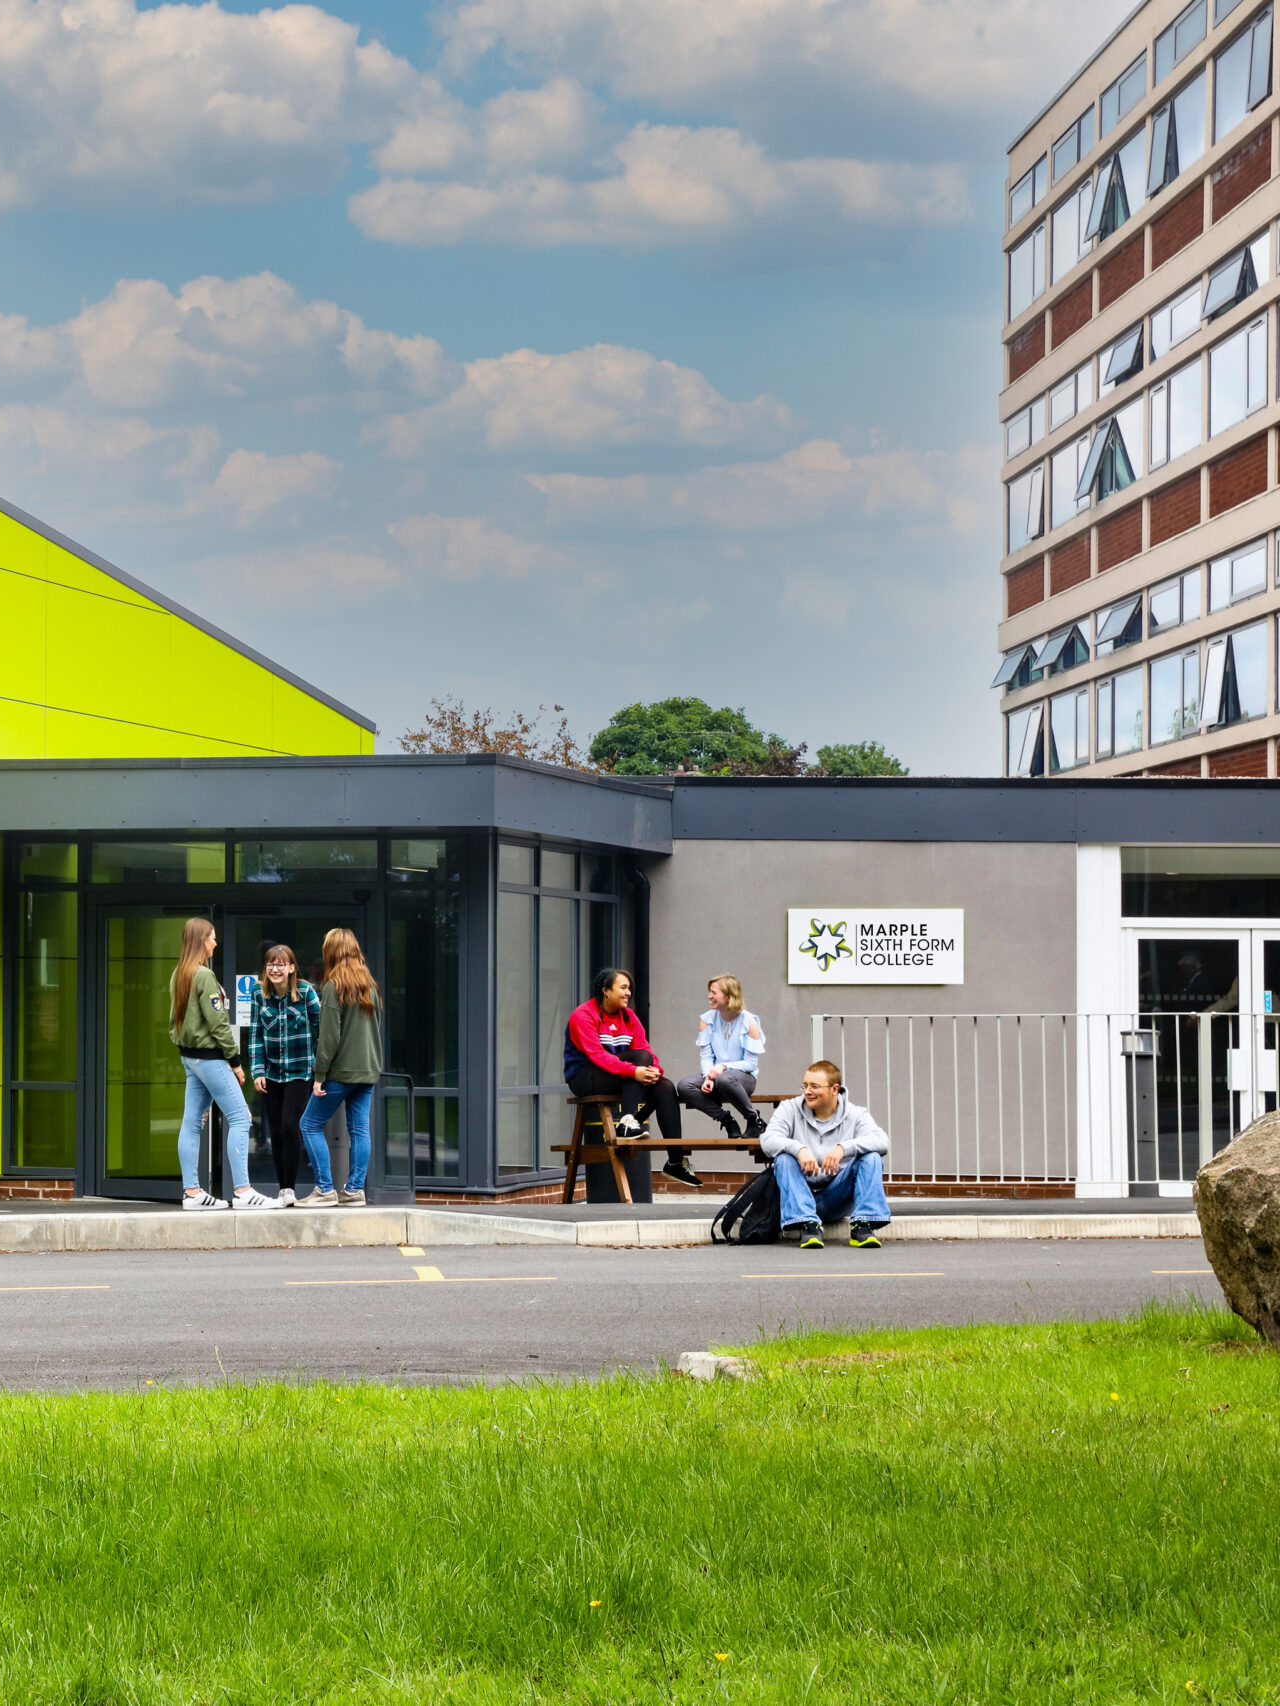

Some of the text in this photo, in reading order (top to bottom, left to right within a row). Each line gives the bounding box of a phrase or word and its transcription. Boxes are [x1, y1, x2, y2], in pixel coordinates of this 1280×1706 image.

[860, 924, 928, 936] MARPLE
[860, 939, 955, 951] SIXTH FORM
[860, 953, 934, 966] COLLEGE
